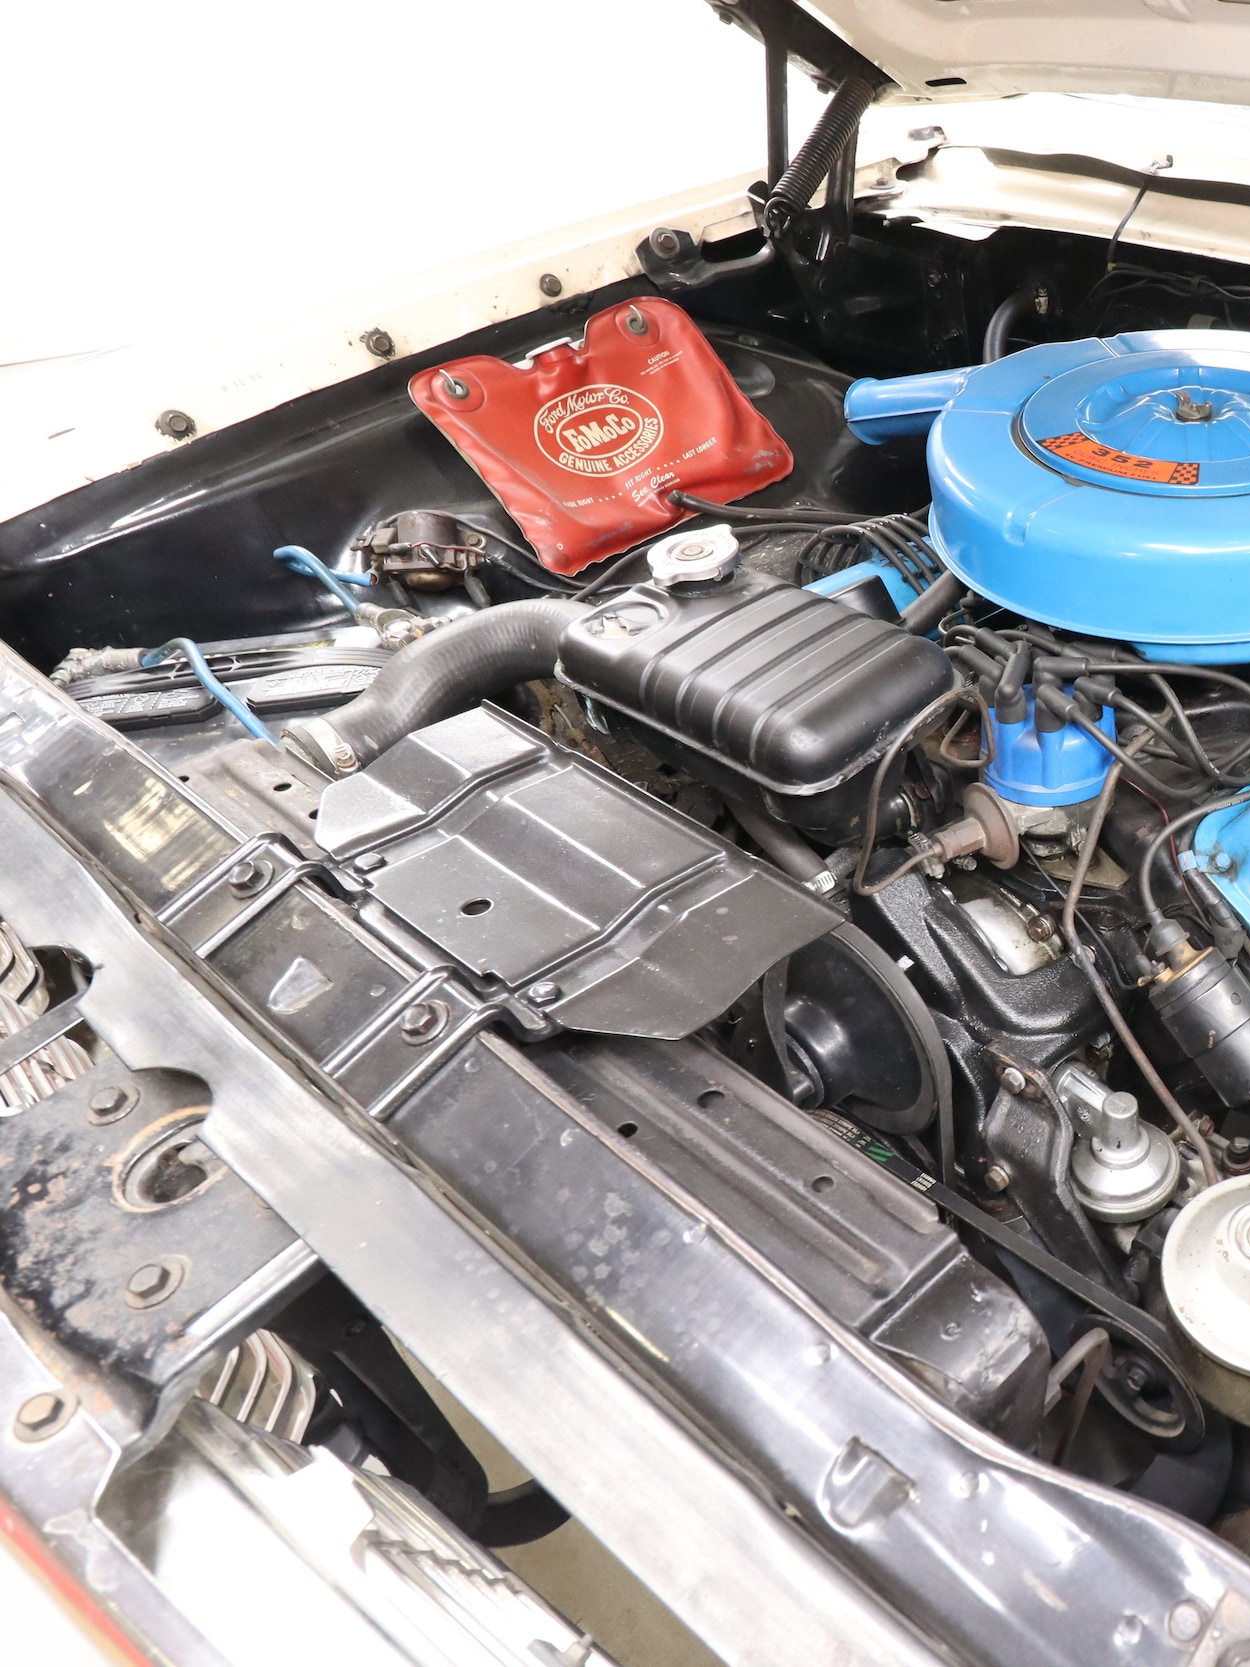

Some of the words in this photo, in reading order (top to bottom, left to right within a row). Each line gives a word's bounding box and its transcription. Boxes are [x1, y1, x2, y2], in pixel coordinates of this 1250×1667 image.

[647, 350, 671, 365] CAUTION
[539, 401, 567, 435] Ford
[563, 391, 605, 418] Motor
[603, 387, 630, 405] Co.
[562, 413, 636, 453] FoMoCo
[558, 452, 613, 473] GENUINE
[612, 417, 659, 468] ACCESSORIES
[624, 478, 635, 491] FIT
[634, 467, 653, 483] RIGHT
[682, 449, 697, 460] LAST
[696, 436, 718, 454] LONGER
[1079, 458, 1127, 476] PREMIUM
[1091, 448, 1154, 469] 352
[650, 471, 676, 489] Clear
[1112, 463, 1160, 477] INCHES
